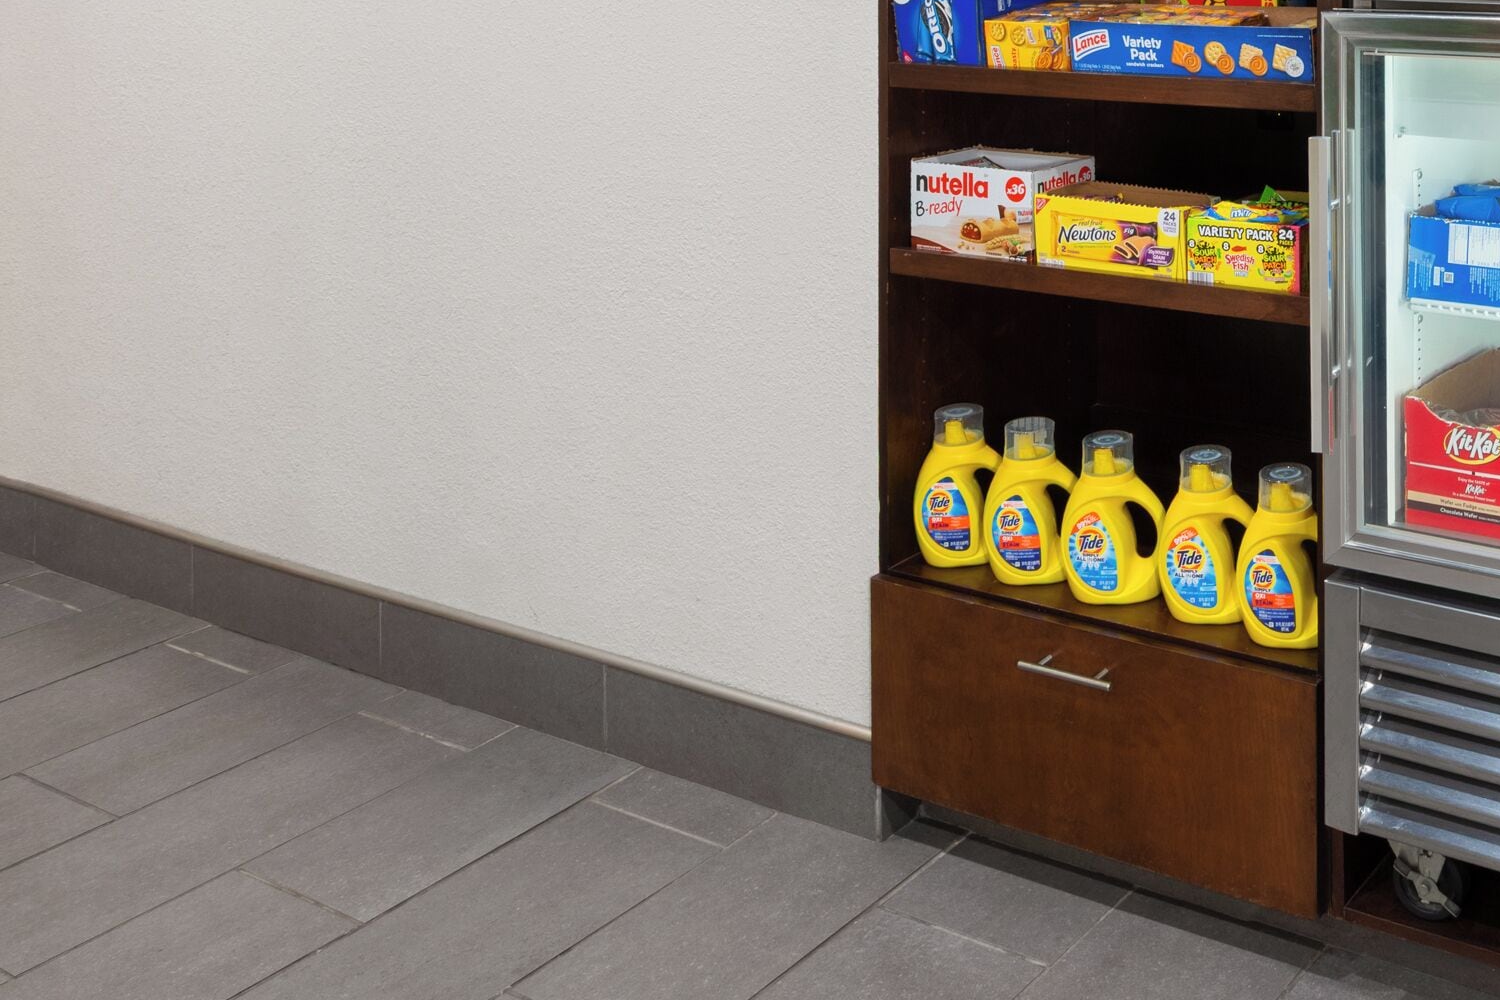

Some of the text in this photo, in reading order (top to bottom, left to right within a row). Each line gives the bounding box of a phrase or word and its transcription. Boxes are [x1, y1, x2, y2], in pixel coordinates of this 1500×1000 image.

[1074, 33, 1107, 53] Lance
[1122, 34, 1162, 49] Variety
[1130, 48, 1158, 61] Pack
[916, 172, 989, 198] nutella
[1006, 183, 1026, 195] x36
[915, 199, 964, 217] B-ready
[1163, 211, 1176, 222] 24
[1058, 224, 1116, 244] Newtons
[1123, 227, 1135, 236] Fig
[1198, 225, 1274, 241] VARIETY PACK
[1278, 229, 1294, 240] 24
[1194, 247, 1216, 256] SOUR
[1257, 246, 1264, 254] 8
[1194, 256, 1217, 264] PATCH
[1225, 254, 1255, 264] Swedish
[1233, 261, 1249, 271] Fish
[1263, 262, 1286, 270] PATCH
[930, 496, 950, 511] Tide
[1000, 514, 1020, 529] Tide
[1079, 534, 1104, 552] Tide
[1177, 550, 1202, 568] Tide
[1253, 570, 1273, 585] Tide
